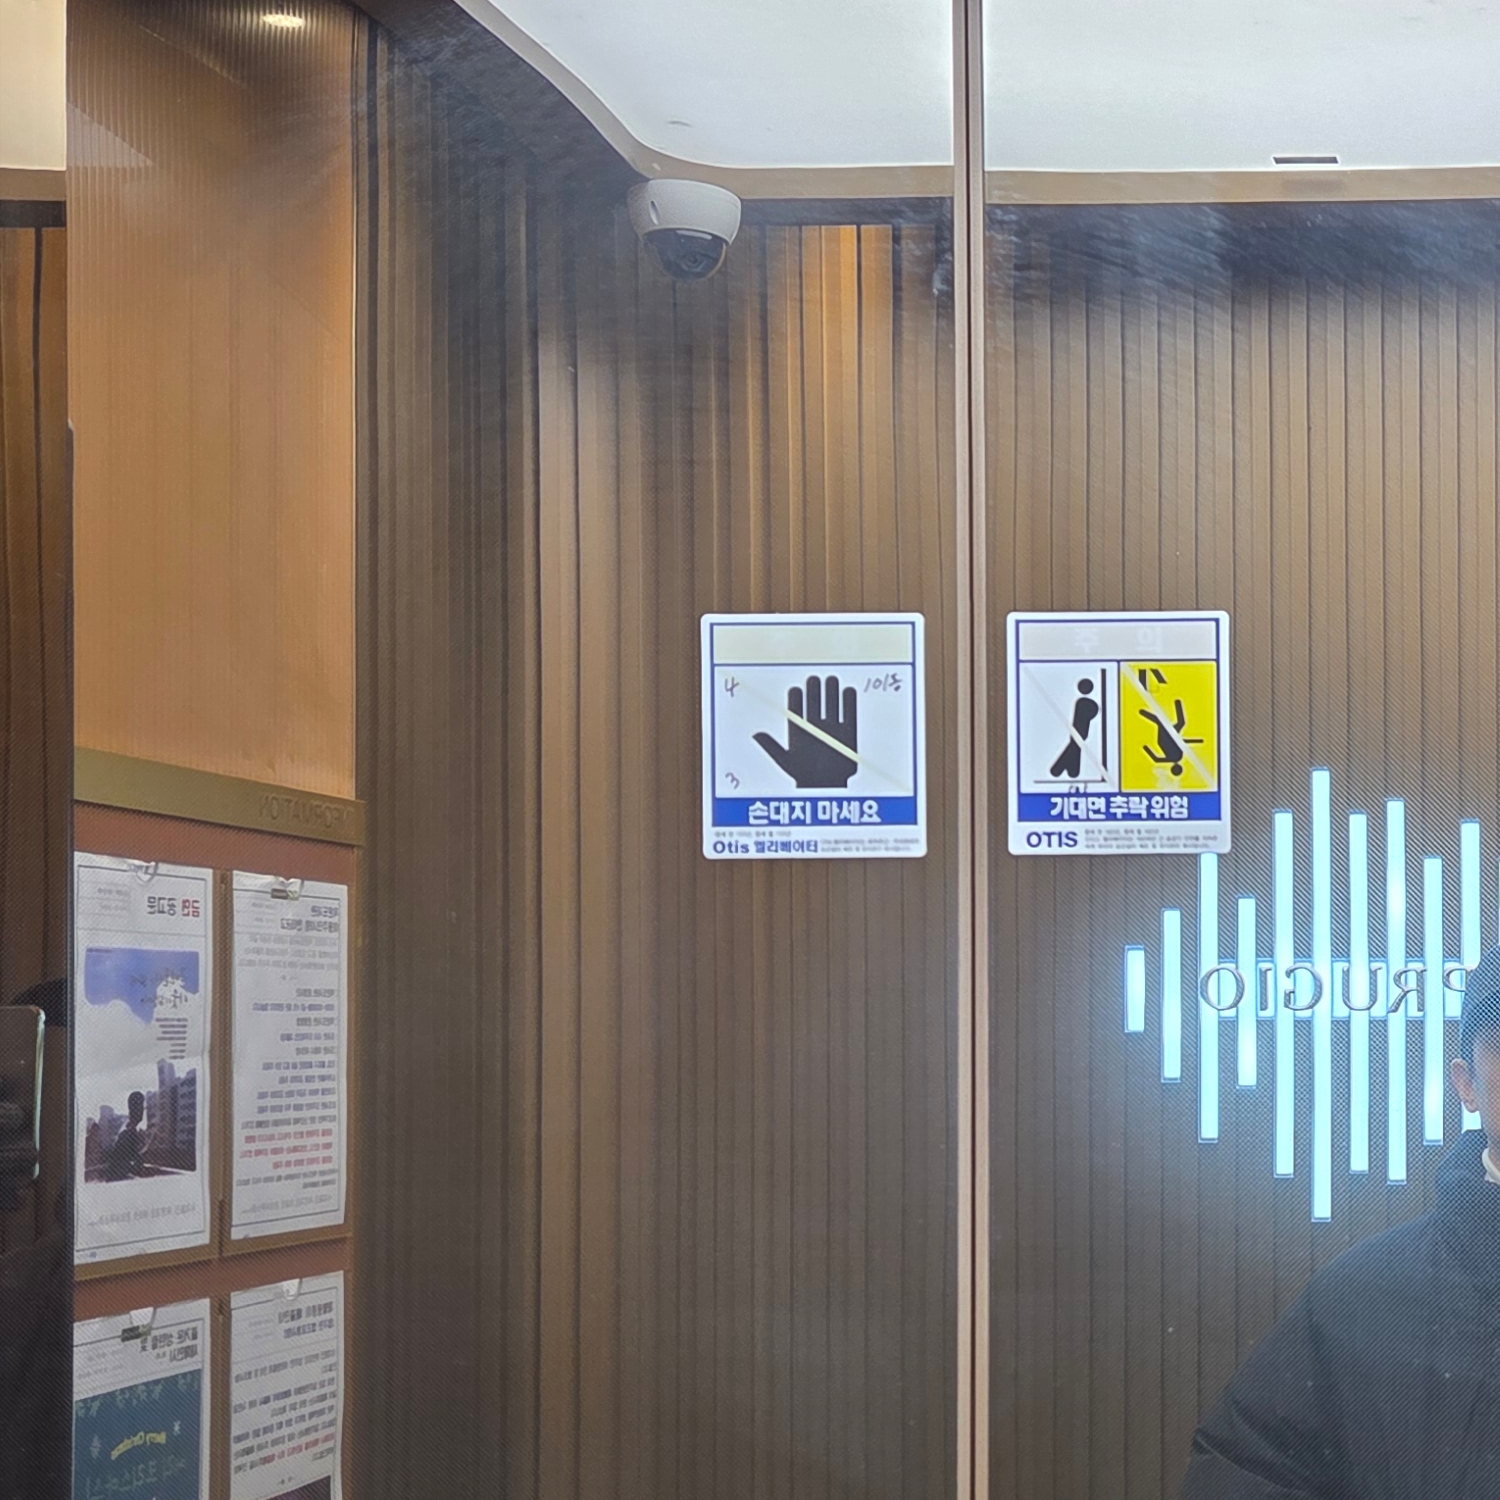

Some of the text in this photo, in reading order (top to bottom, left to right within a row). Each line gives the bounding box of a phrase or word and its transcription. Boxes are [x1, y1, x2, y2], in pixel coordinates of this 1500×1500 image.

[748, 800, 882, 824] 손대지 마세요
[1050, 795, 1189, 820] 기대면 추락 위험
[713, 839, 750, 854] Otis
[753, 838, 818, 854] 엘리베이터
[1026, 831, 1079, 848] OTIS
